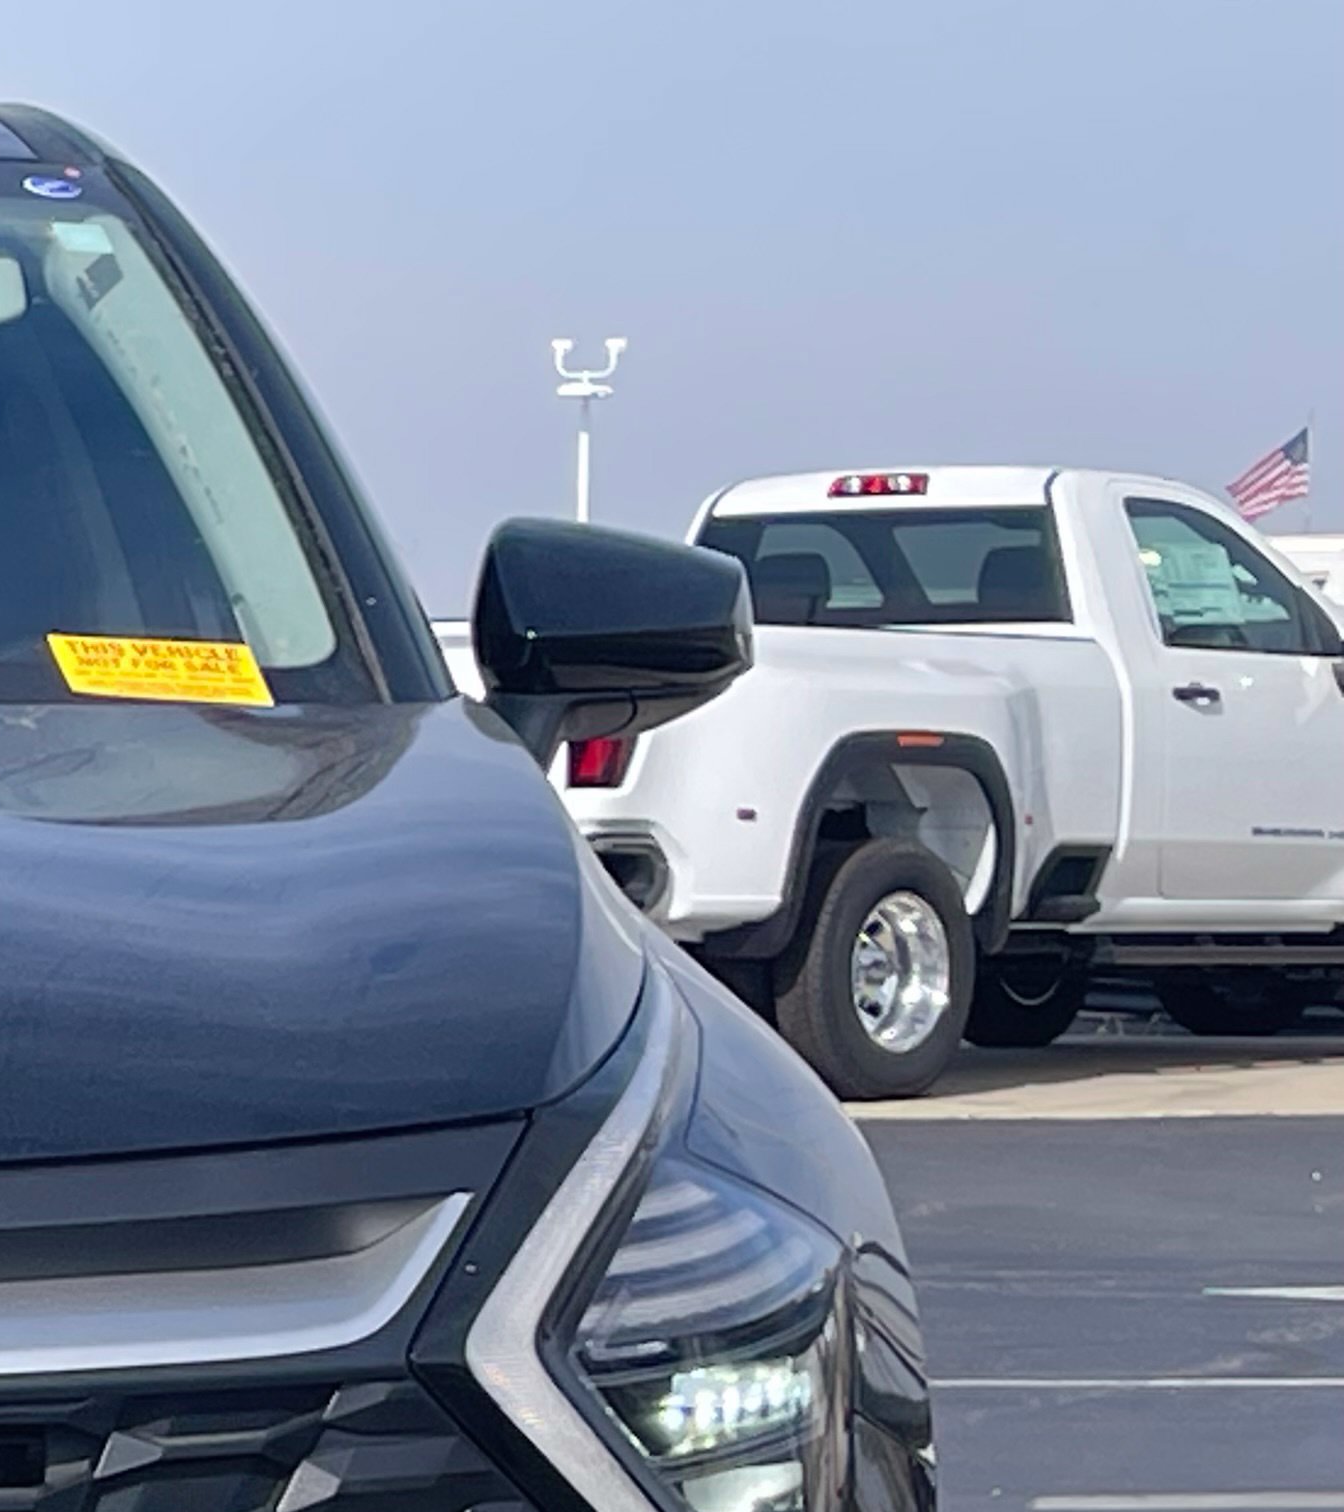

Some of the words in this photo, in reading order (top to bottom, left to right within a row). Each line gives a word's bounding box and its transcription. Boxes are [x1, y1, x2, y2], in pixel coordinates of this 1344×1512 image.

[64, 640, 125, 657] THIS
[131, 642, 242, 661] VEHICLE
[76, 656, 121, 668] NOT
[131, 658, 178, 670] FOR
[184, 660, 243, 675] SALE
